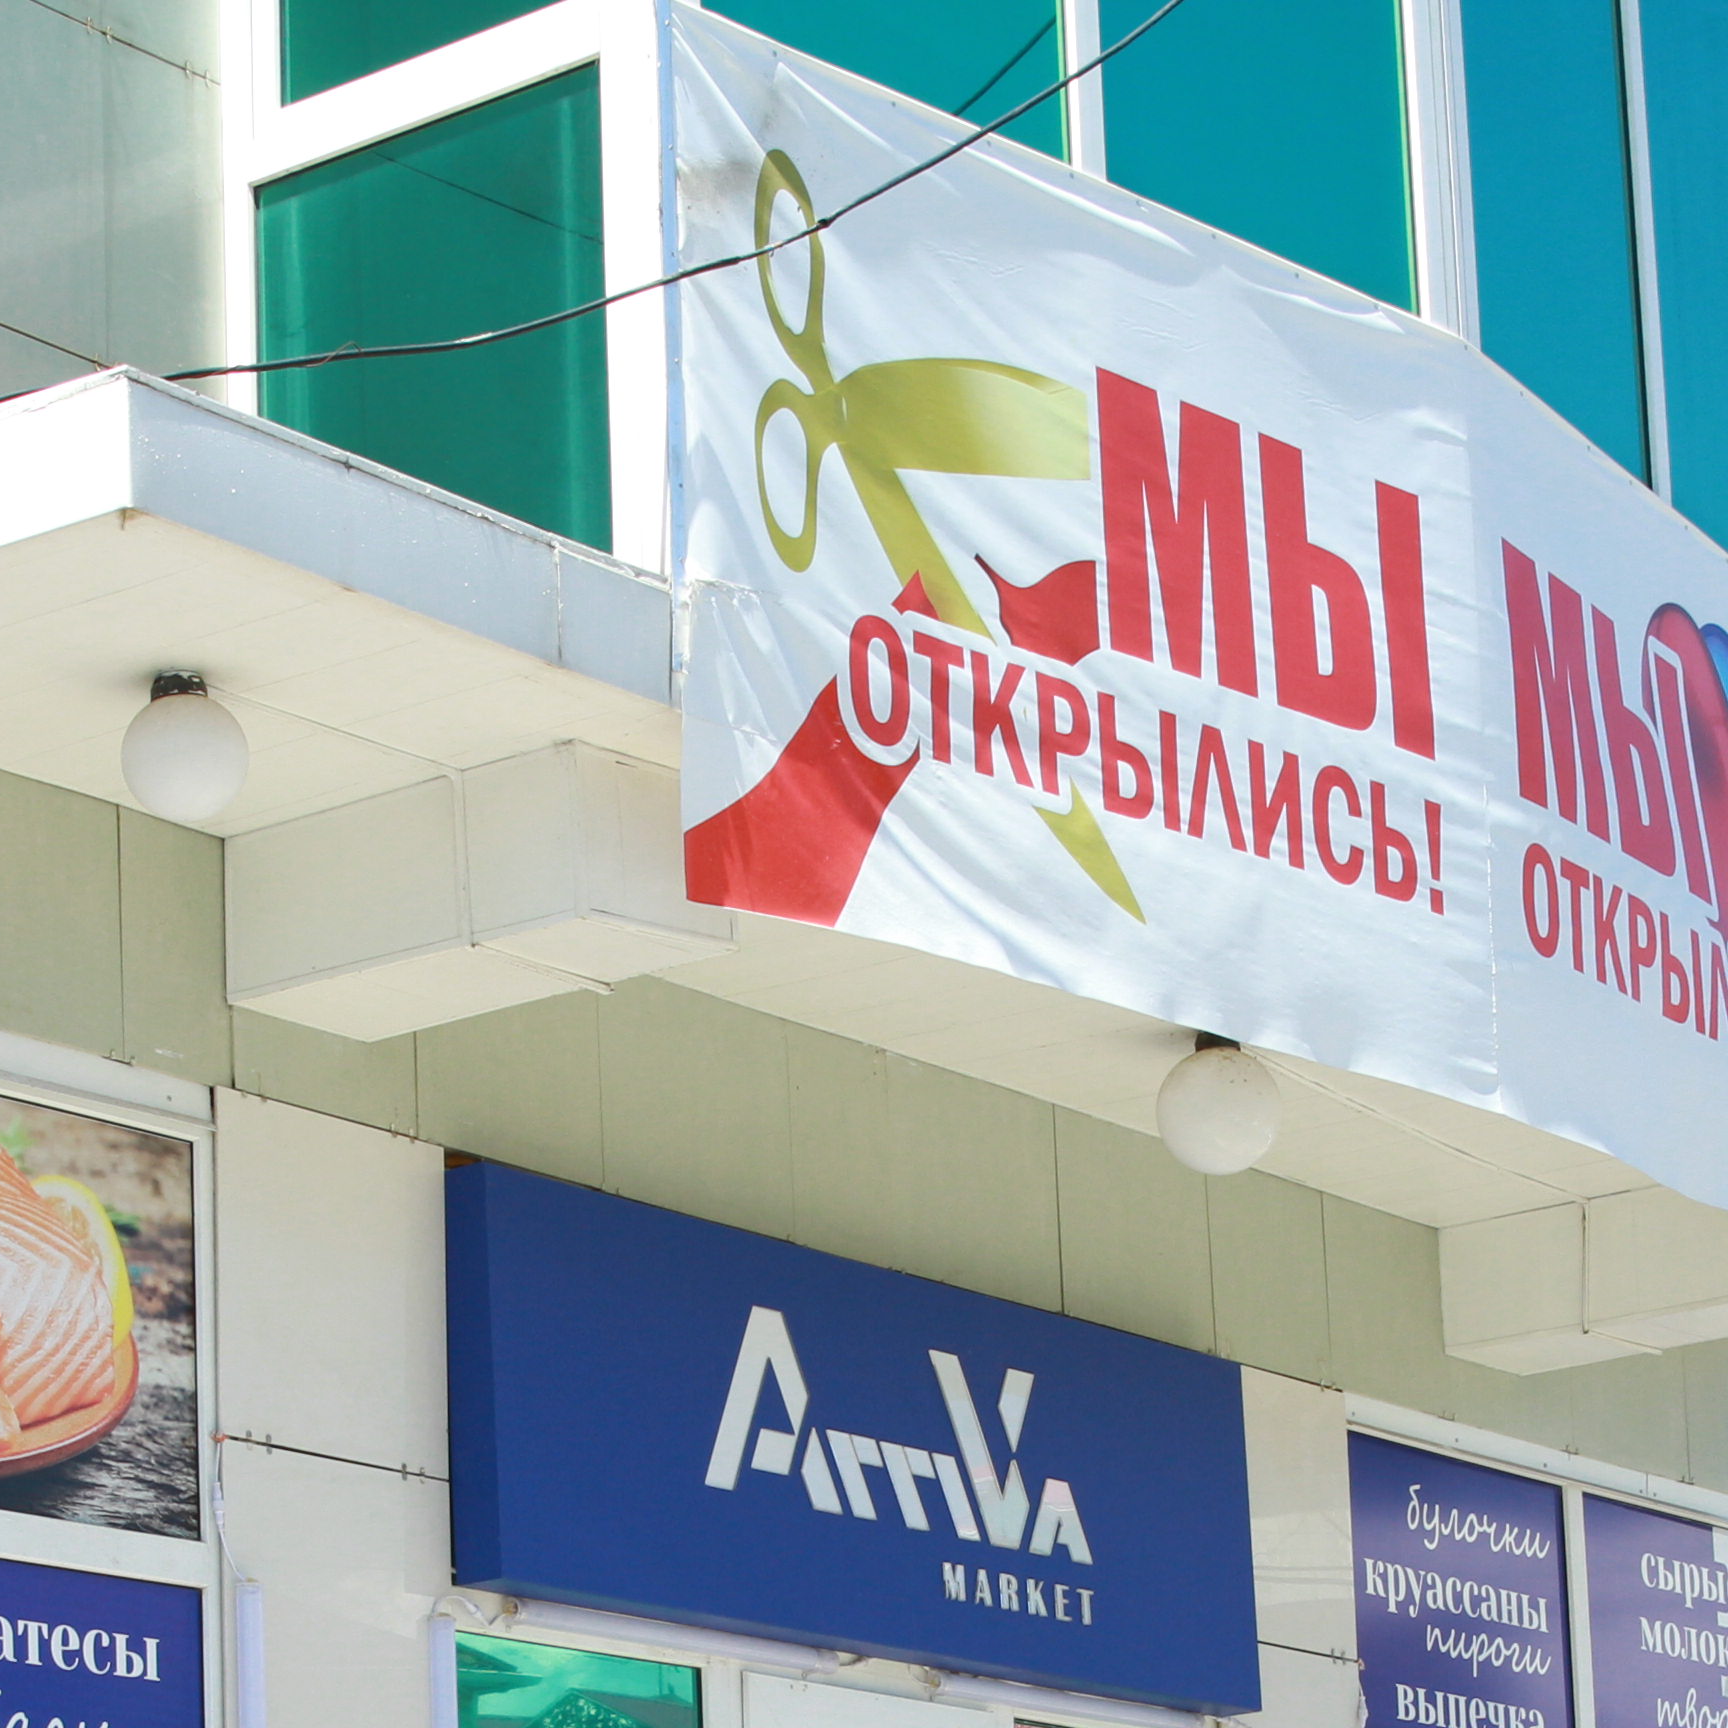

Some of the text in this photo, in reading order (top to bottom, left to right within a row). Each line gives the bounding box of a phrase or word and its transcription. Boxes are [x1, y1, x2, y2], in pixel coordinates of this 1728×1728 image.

[1095, 365, 1437, 762] МЫ
[1500, 535, 1714, 907] МЫ
[849, 613, 1446, 917] ОТКРЫЛИСЬ!
[1406, 1484, 1551, 1561] булочки
[942, 1561, 1095, 1626] MARKET
[1363, 1557, 1549, 1633] круассаны
[1640, 1551, 1728, 1610] сыры
[1425, 1620, 1552, 1678] пироги
